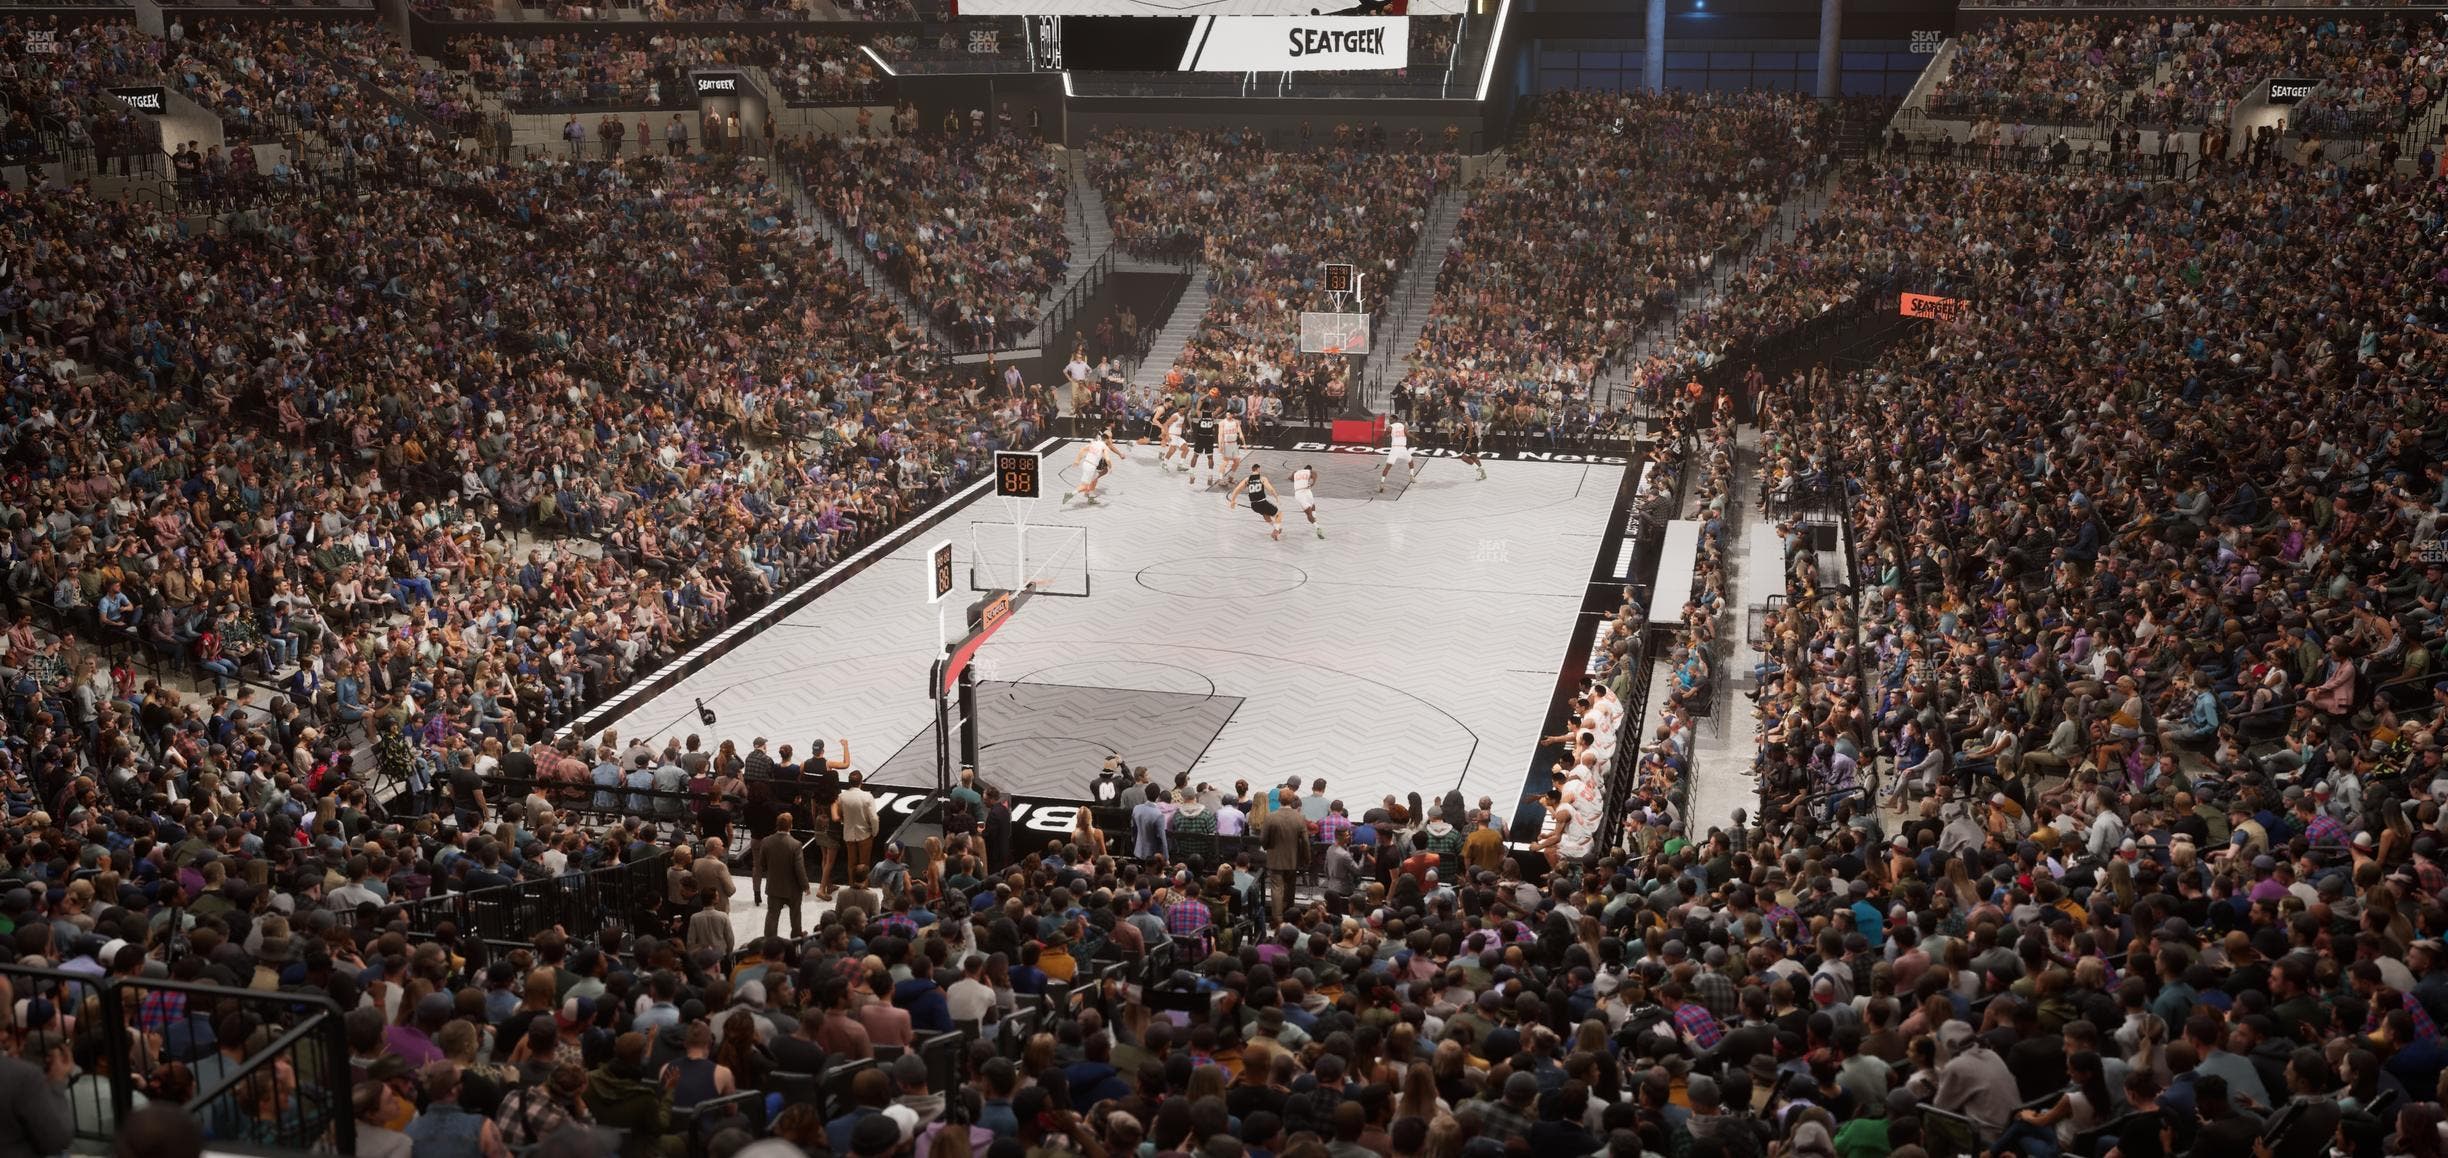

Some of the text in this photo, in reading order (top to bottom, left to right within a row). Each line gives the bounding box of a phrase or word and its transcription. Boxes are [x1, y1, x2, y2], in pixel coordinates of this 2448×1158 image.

[1289, 26, 1385, 57] SEATGEEK
[698, 80, 735, 91] SEATGEEK
[118, 93, 160, 108] EATGEEK
[1517, 451, 1628, 464] Nets
